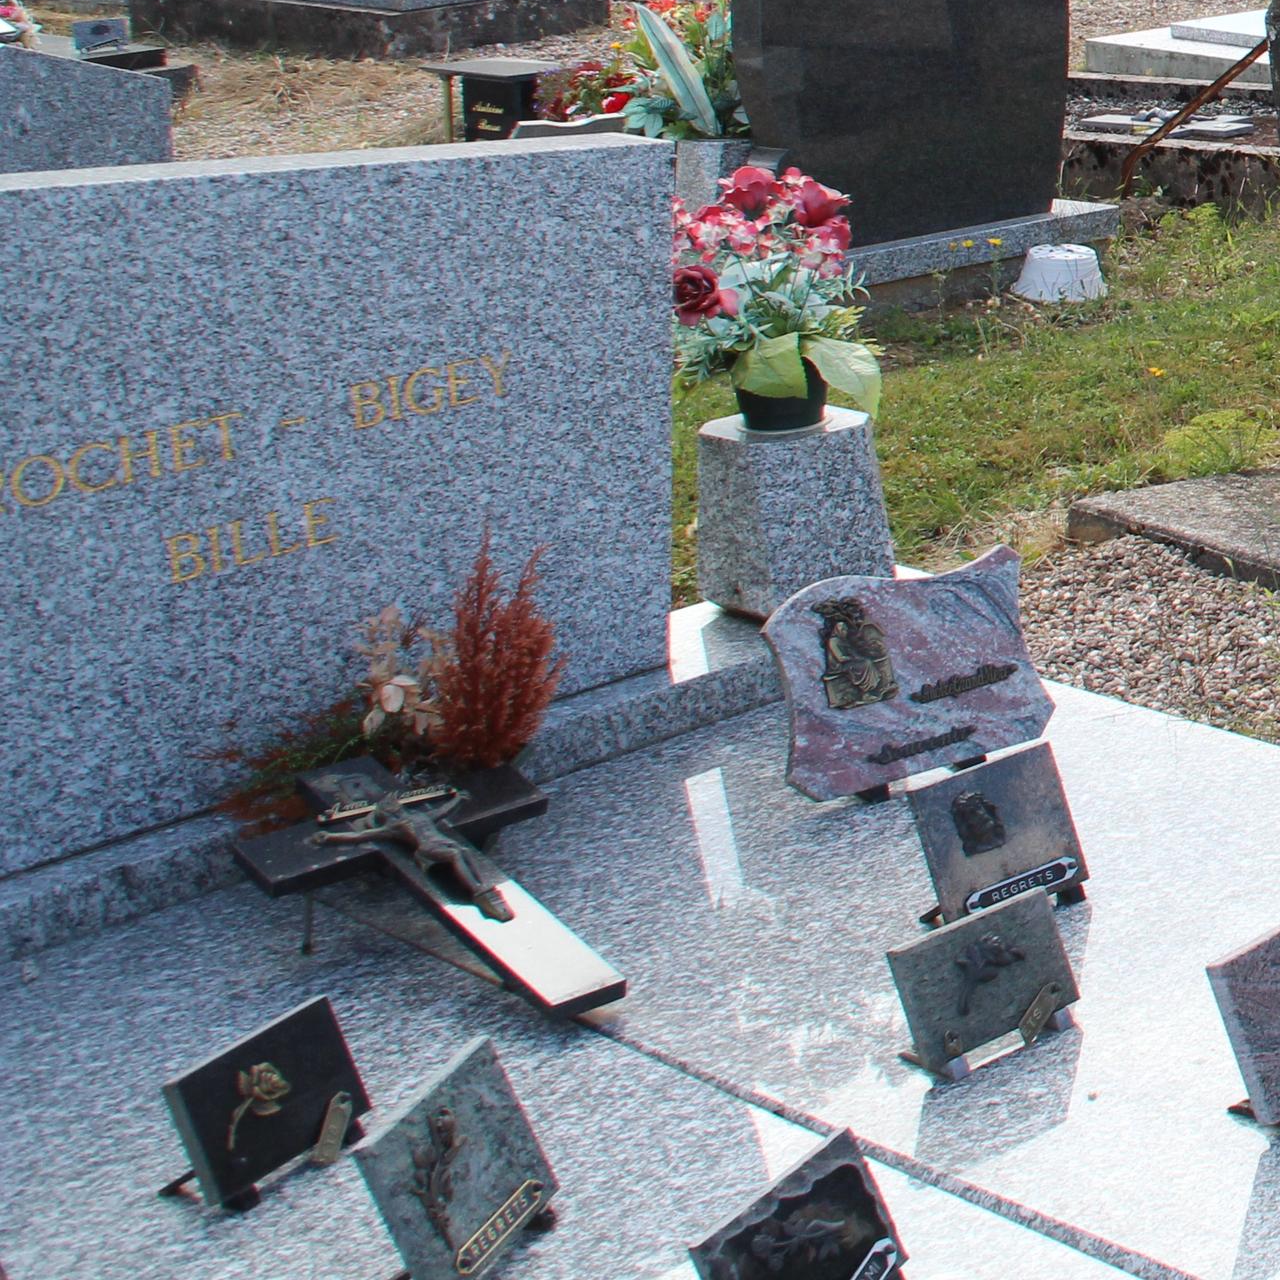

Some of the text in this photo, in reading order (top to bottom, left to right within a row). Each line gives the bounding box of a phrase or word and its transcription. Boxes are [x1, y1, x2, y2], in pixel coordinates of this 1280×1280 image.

[0, 412, 243, 514] OCHET
[350, 350, 513, 430] BIGEY
[165, 496, 341, 584] BILLE
[991, 869, 1054, 902] REGRETS
[469, 1193, 529, 1260] REGRETS
